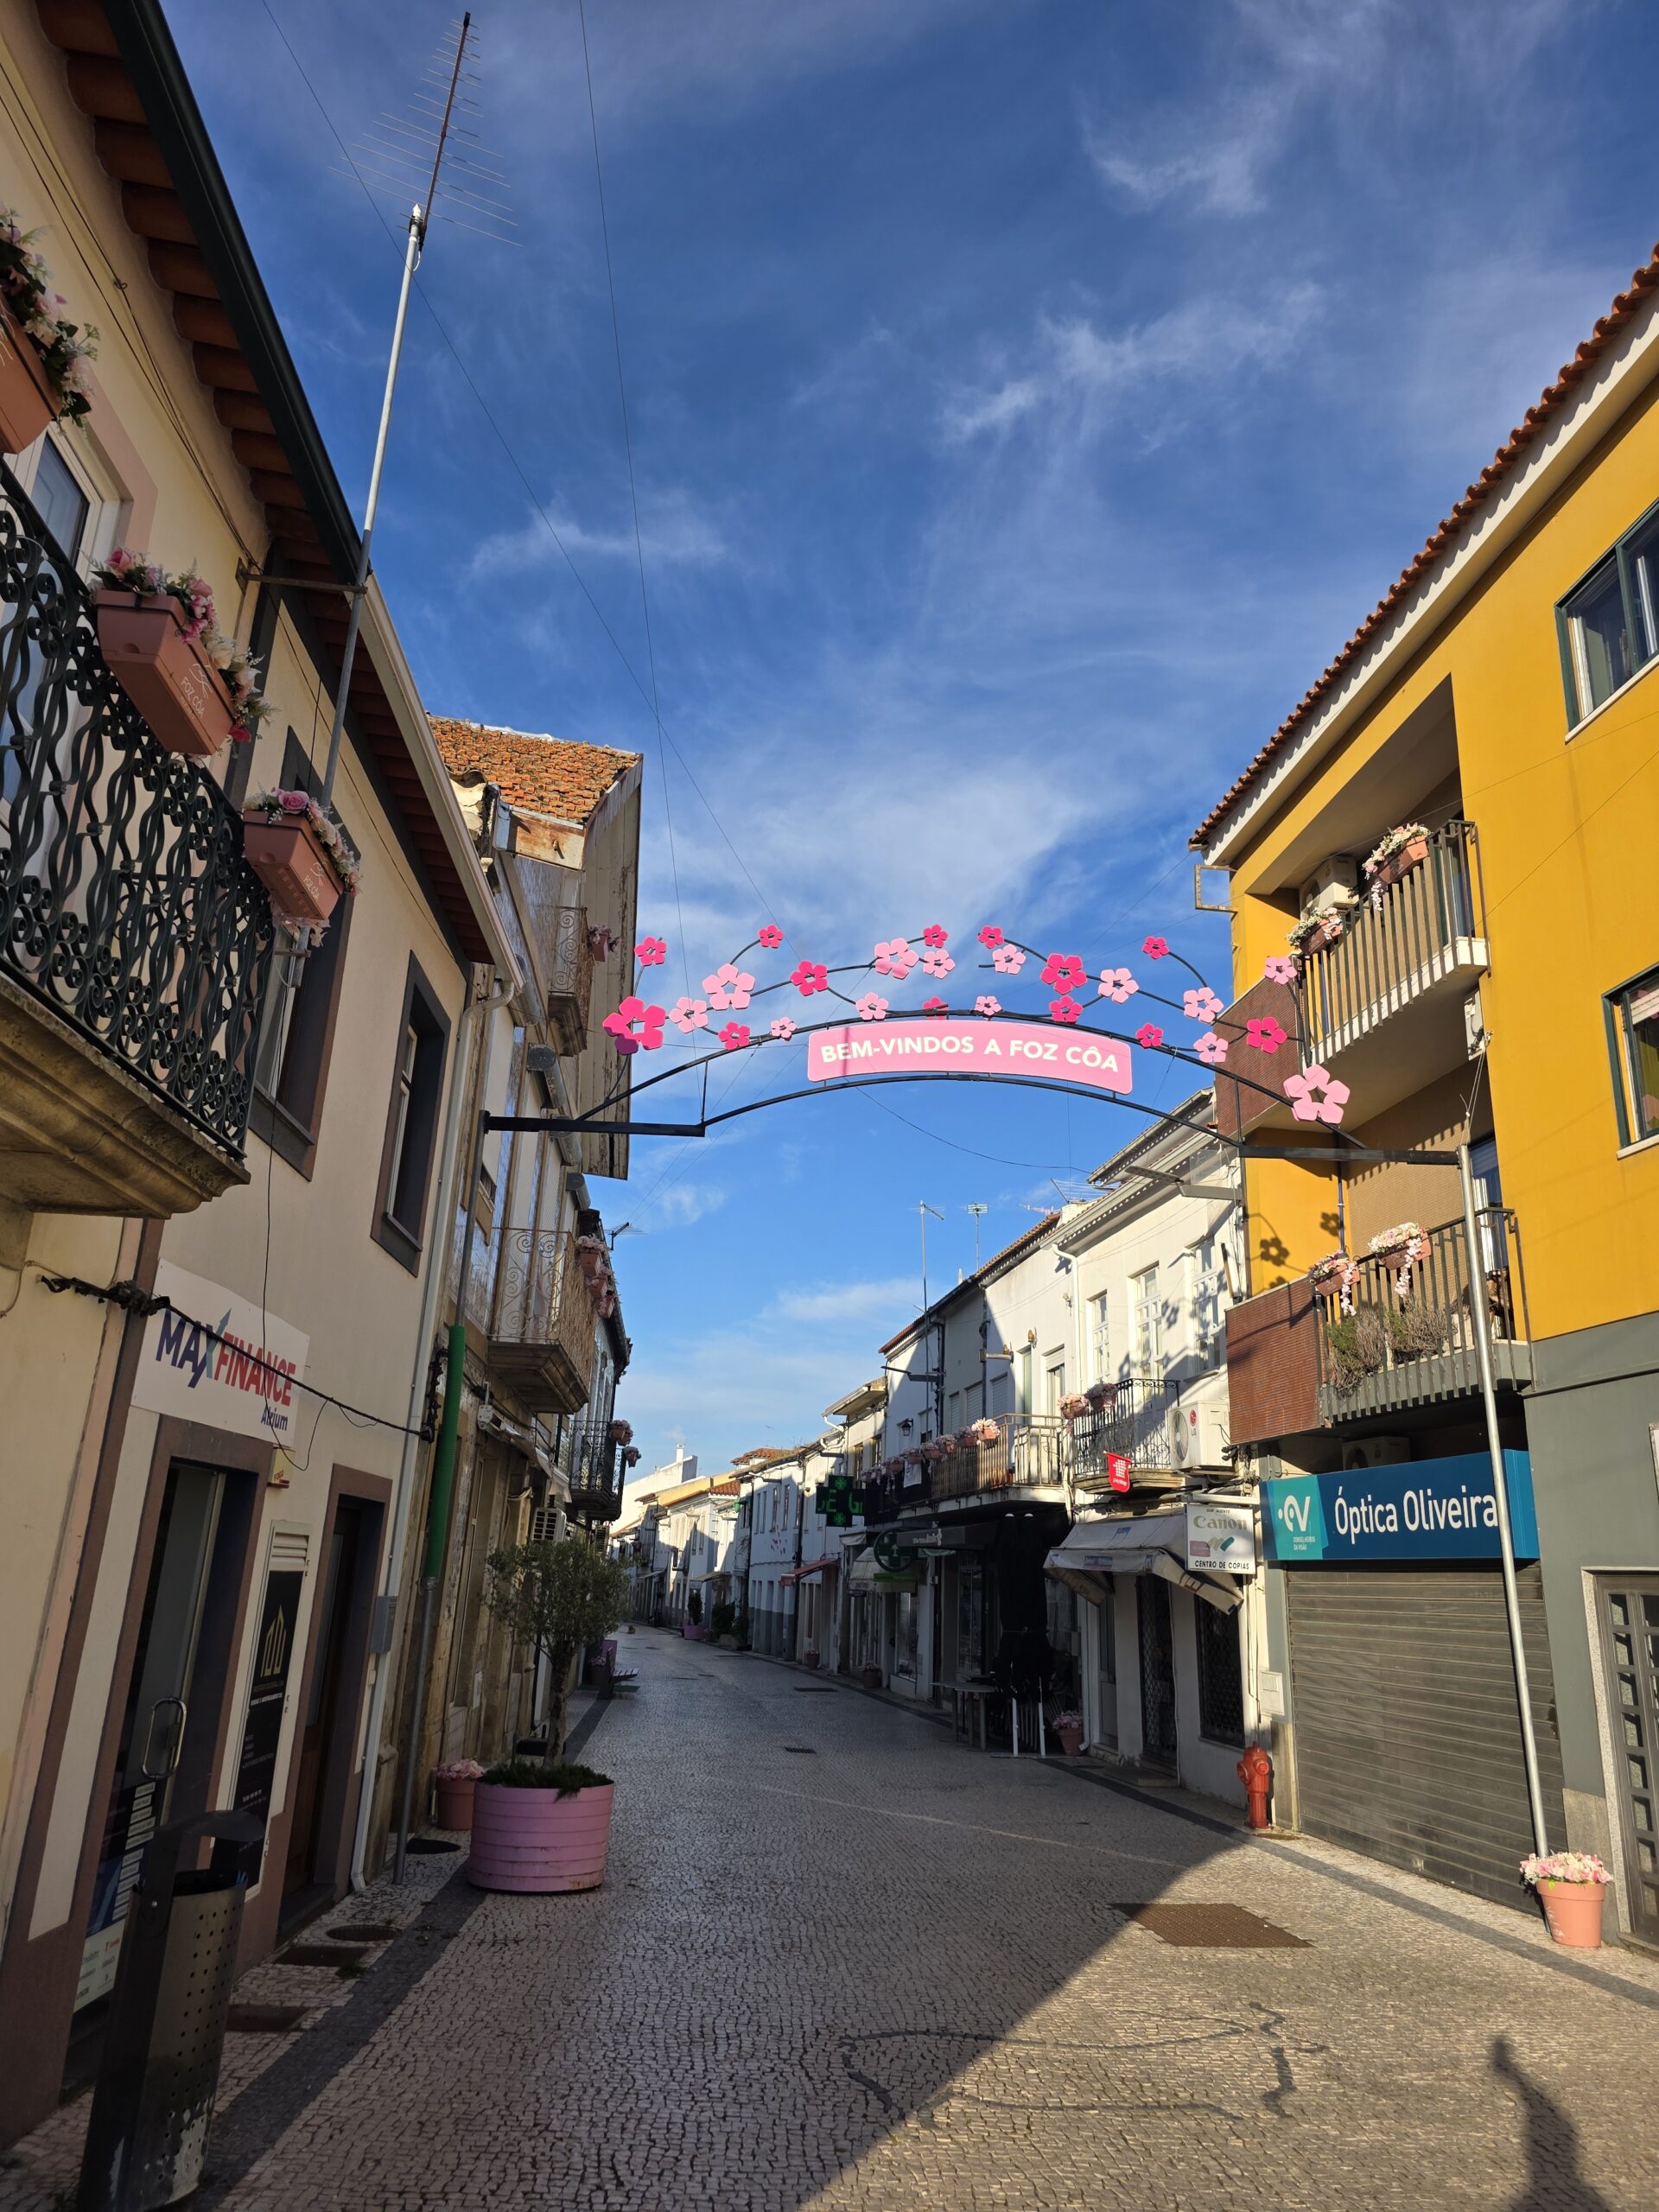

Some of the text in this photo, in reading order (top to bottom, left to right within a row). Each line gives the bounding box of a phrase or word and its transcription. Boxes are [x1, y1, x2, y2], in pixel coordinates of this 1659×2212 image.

[181, 677, 194, 701] FOZ
[820, 1036, 1119, 1072] BEM-VINDOS A FOZ CÔA
[261, 1406, 289, 1431] Atrium
[1193, 1515, 1247, 1530] Canon
[1335, 1484, 1498, 1544] Óptica Oliveira
[1195, 1560, 1217, 1568] CENTRO
